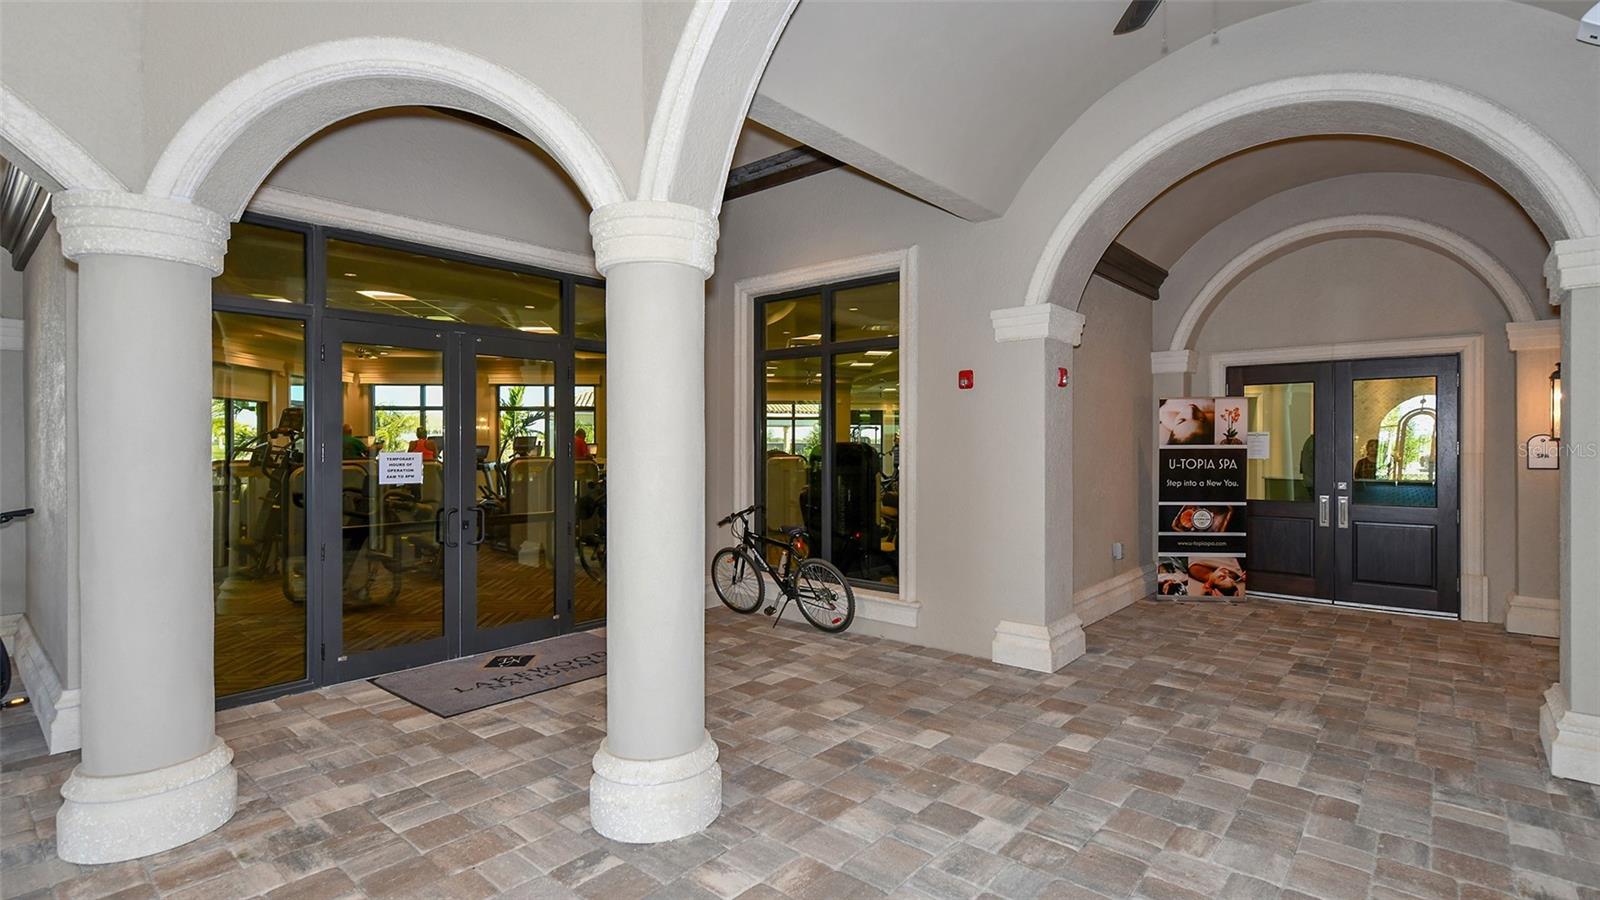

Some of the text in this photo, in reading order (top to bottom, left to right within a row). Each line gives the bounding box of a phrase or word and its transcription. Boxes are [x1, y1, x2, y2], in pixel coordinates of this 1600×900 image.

[1169, 458, 1238, 470] U-TOPIA SPA
[1166, 479, 1182, 488] Step
[1184, 479, 1197, 487] into
[1206, 479, 1222, 487] New
[1224, 479, 1239, 487] You.
[454, 651, 607, 694] LAKEWOOD
[488, 659, 605, 692] NATIONAL
